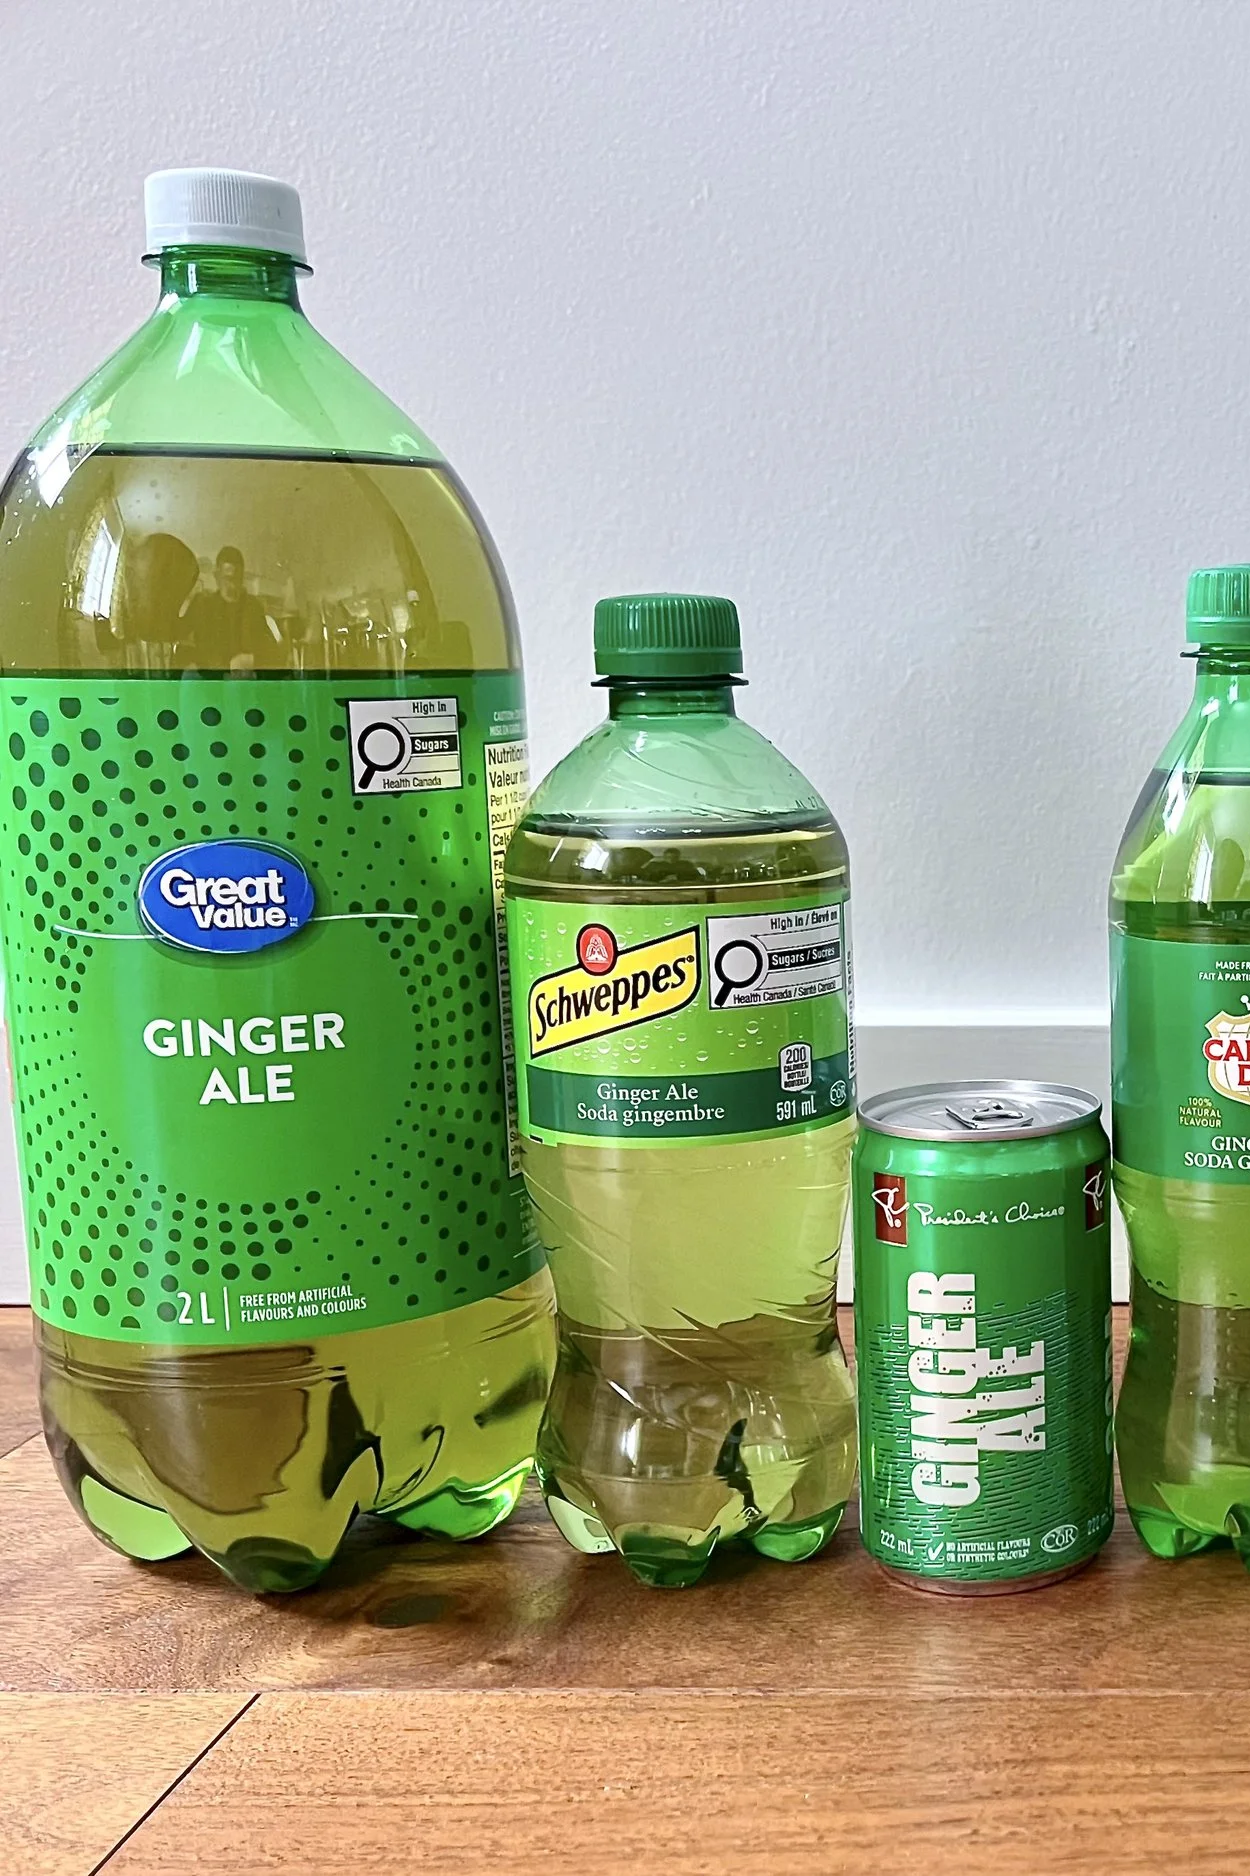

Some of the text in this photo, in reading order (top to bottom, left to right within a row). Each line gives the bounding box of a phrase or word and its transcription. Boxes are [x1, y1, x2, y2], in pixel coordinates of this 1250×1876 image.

[412, 701, 447, 715] High in
[414, 739, 449, 751] Sugars
[383, 776, 442, 789] Health Canada
[489, 770, 518, 788] Valeur
[490, 794, 503, 807] Per
[159, 868, 286, 906] Great
[190, 903, 287, 928] Value
[770, 918, 793, 931] High
[795, 916, 804, 927] in
[772, 952, 805, 967] Sugars
[1215, 961, 1240, 970] MADE
[1199, 972, 1216, 981] FAIT
[535, 957, 687, 1042] Schweppes
[733, 989, 792, 1005] Health Canada
[143, 1012, 345, 1057] GINGER
[786, 1046, 807, 1064] 200
[199, 1064, 295, 1105] ALE
[596, 1083, 698, 1105] Ginger Ale
[776, 1095, 817, 1121] 591 mL
[1179, 1106, 1222, 1118] NATURAL
[1188, 1097, 1213, 1107] 100%
[577, 1103, 725, 1127] Soda gingembre
[1179, 1117, 1222, 1128] FLAVOUR
[1184, 1151, 1235, 1169] SODA
[913, 1202, 1059, 1226] President's Choice
[240, 1285, 353, 1307] FREE FROM ARTIFICIAL
[177, 1291, 216, 1325] 2 L
[240, 1297, 367, 1322] FLAVOURS AND COLOURS
[907, 1271, 981, 1507] GINGER
[975, 1340, 1046, 1451] ALE
[880, 1529, 914, 1555] 222 mL
